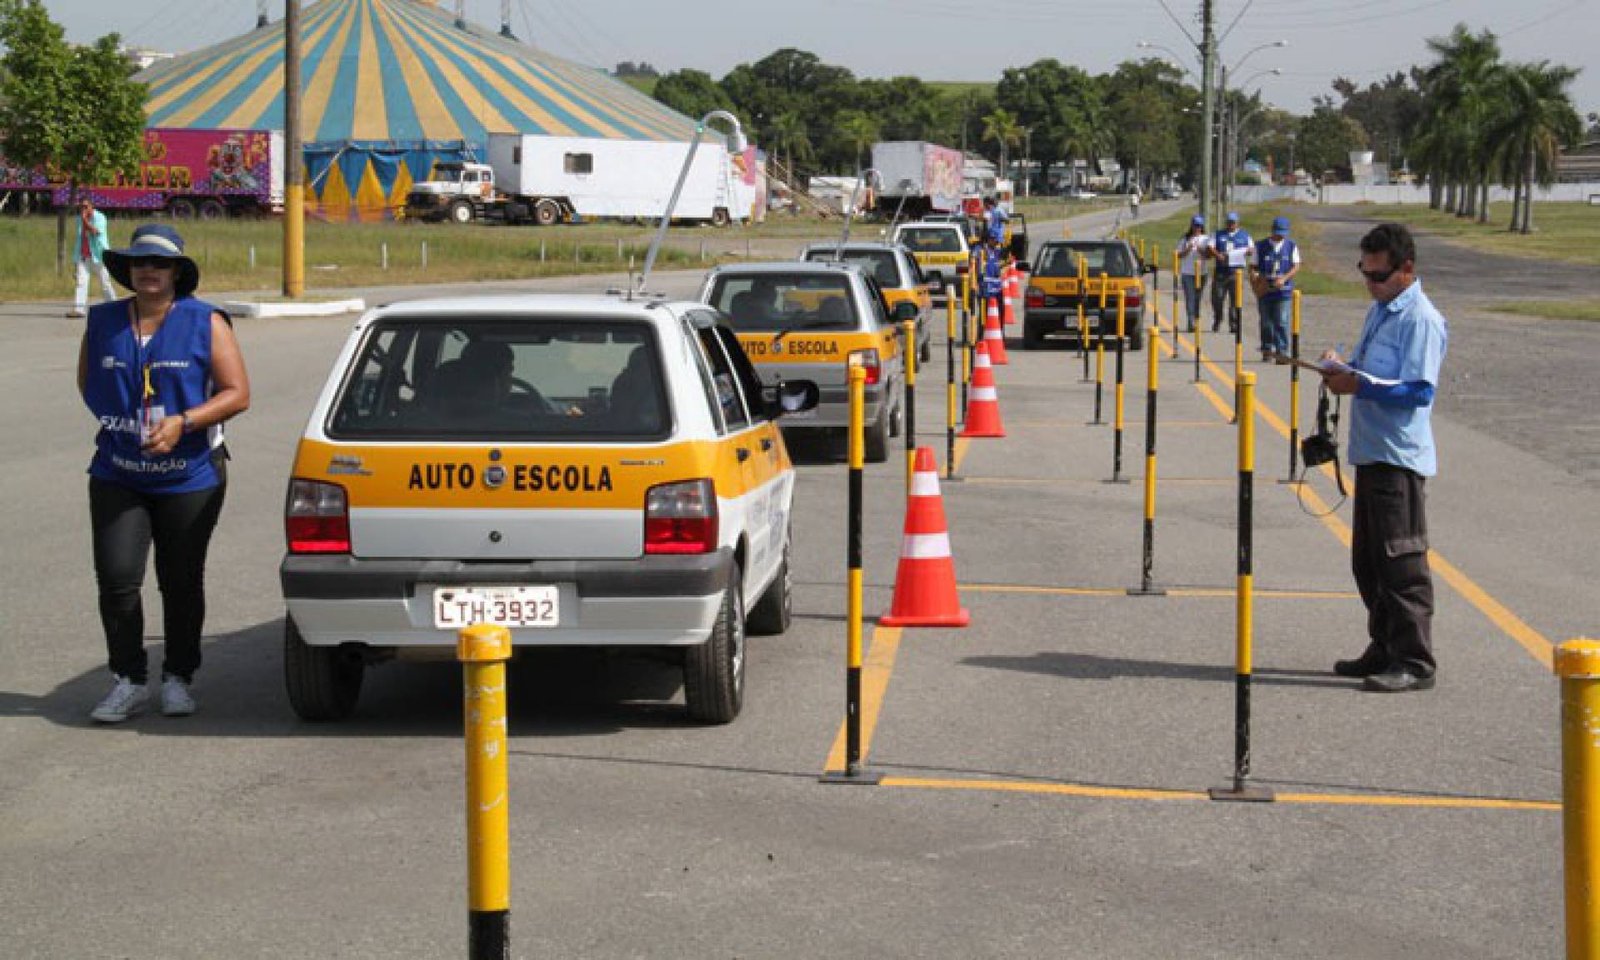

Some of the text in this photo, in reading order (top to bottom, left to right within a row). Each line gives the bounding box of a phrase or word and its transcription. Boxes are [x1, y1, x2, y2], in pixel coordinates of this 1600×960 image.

[741, 340, 839, 355] UTO ESCOLA
[409, 463, 613, 492] AUTO ESCOLA
